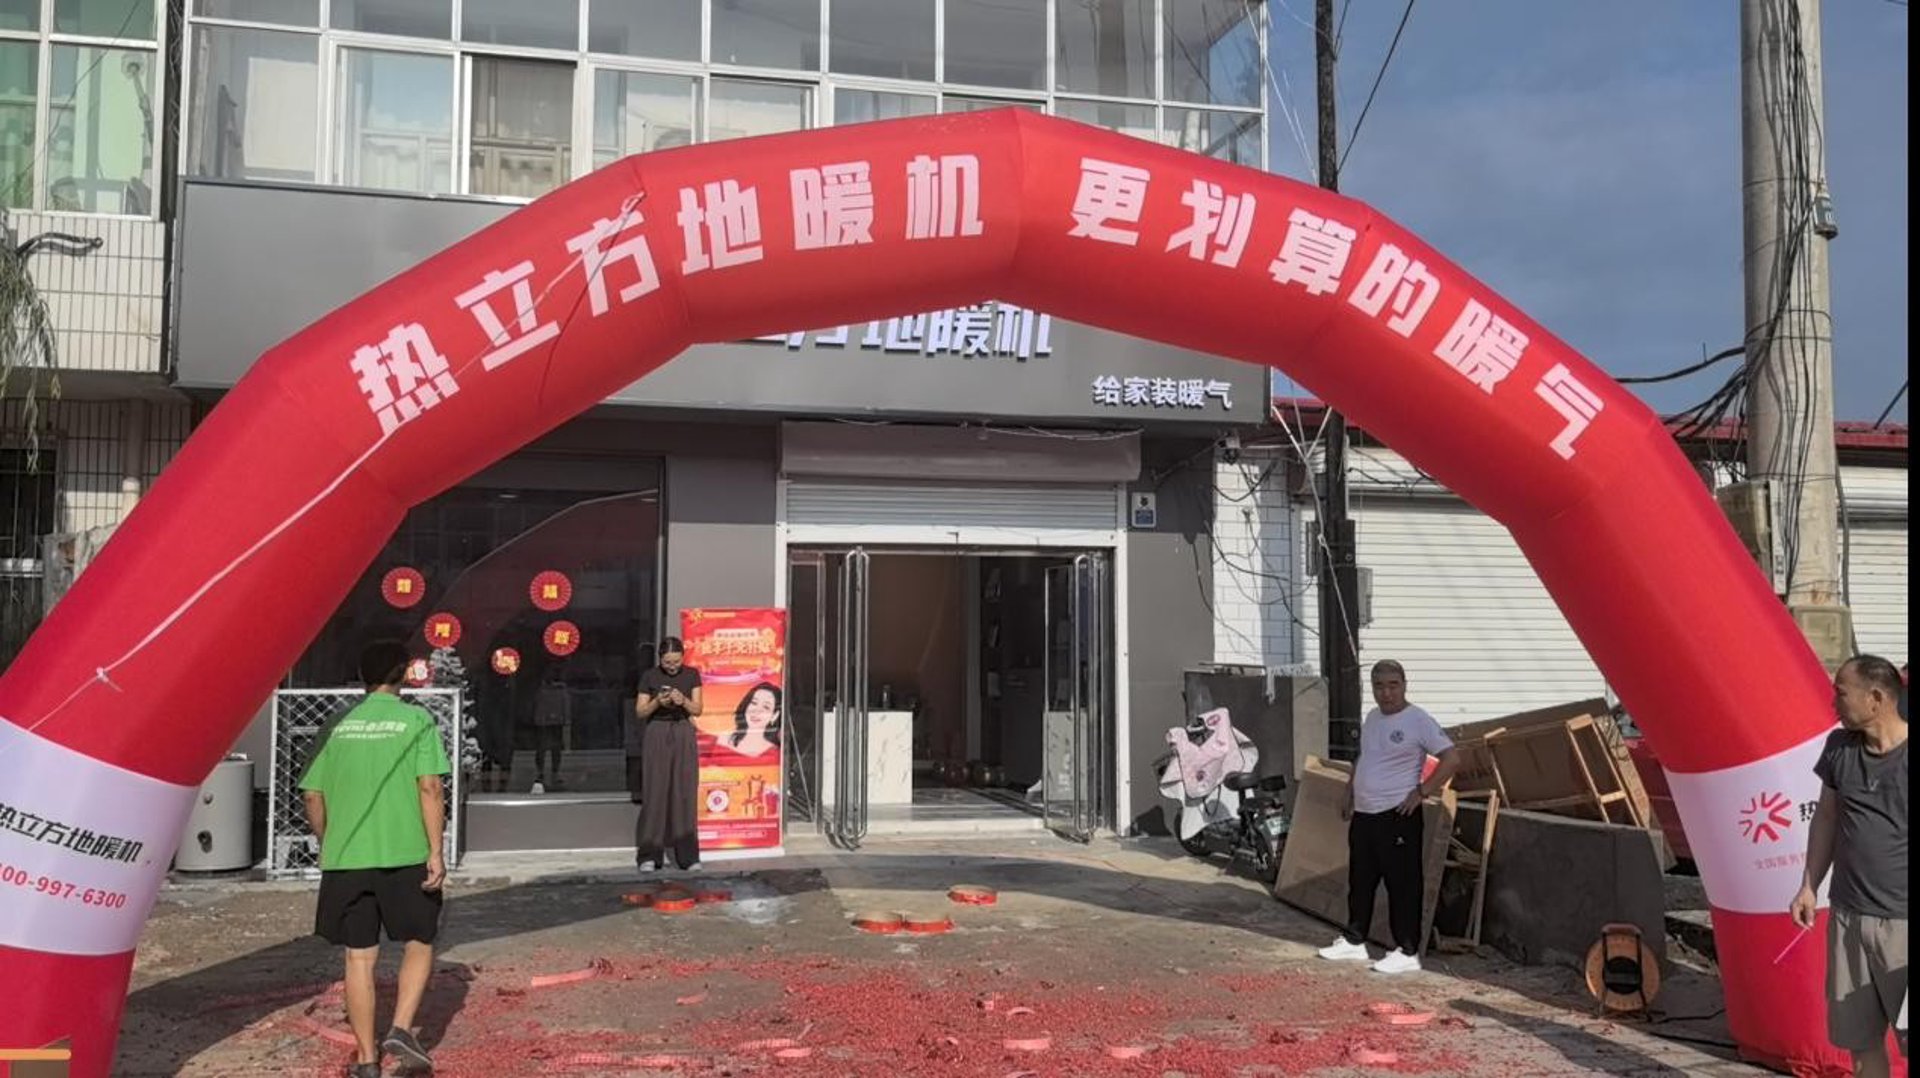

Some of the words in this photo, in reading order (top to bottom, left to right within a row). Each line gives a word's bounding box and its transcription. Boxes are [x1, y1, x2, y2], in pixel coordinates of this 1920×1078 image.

[350, 155, 984, 437] 热立方地暖机
[1067, 157, 1605, 461] 更划算的暖气
[742, 300, 1053, 361] 地暖机
[1092, 375, 1232, 409] 给家装暖气
[0, 863, 127, 909] 00-997-6300
